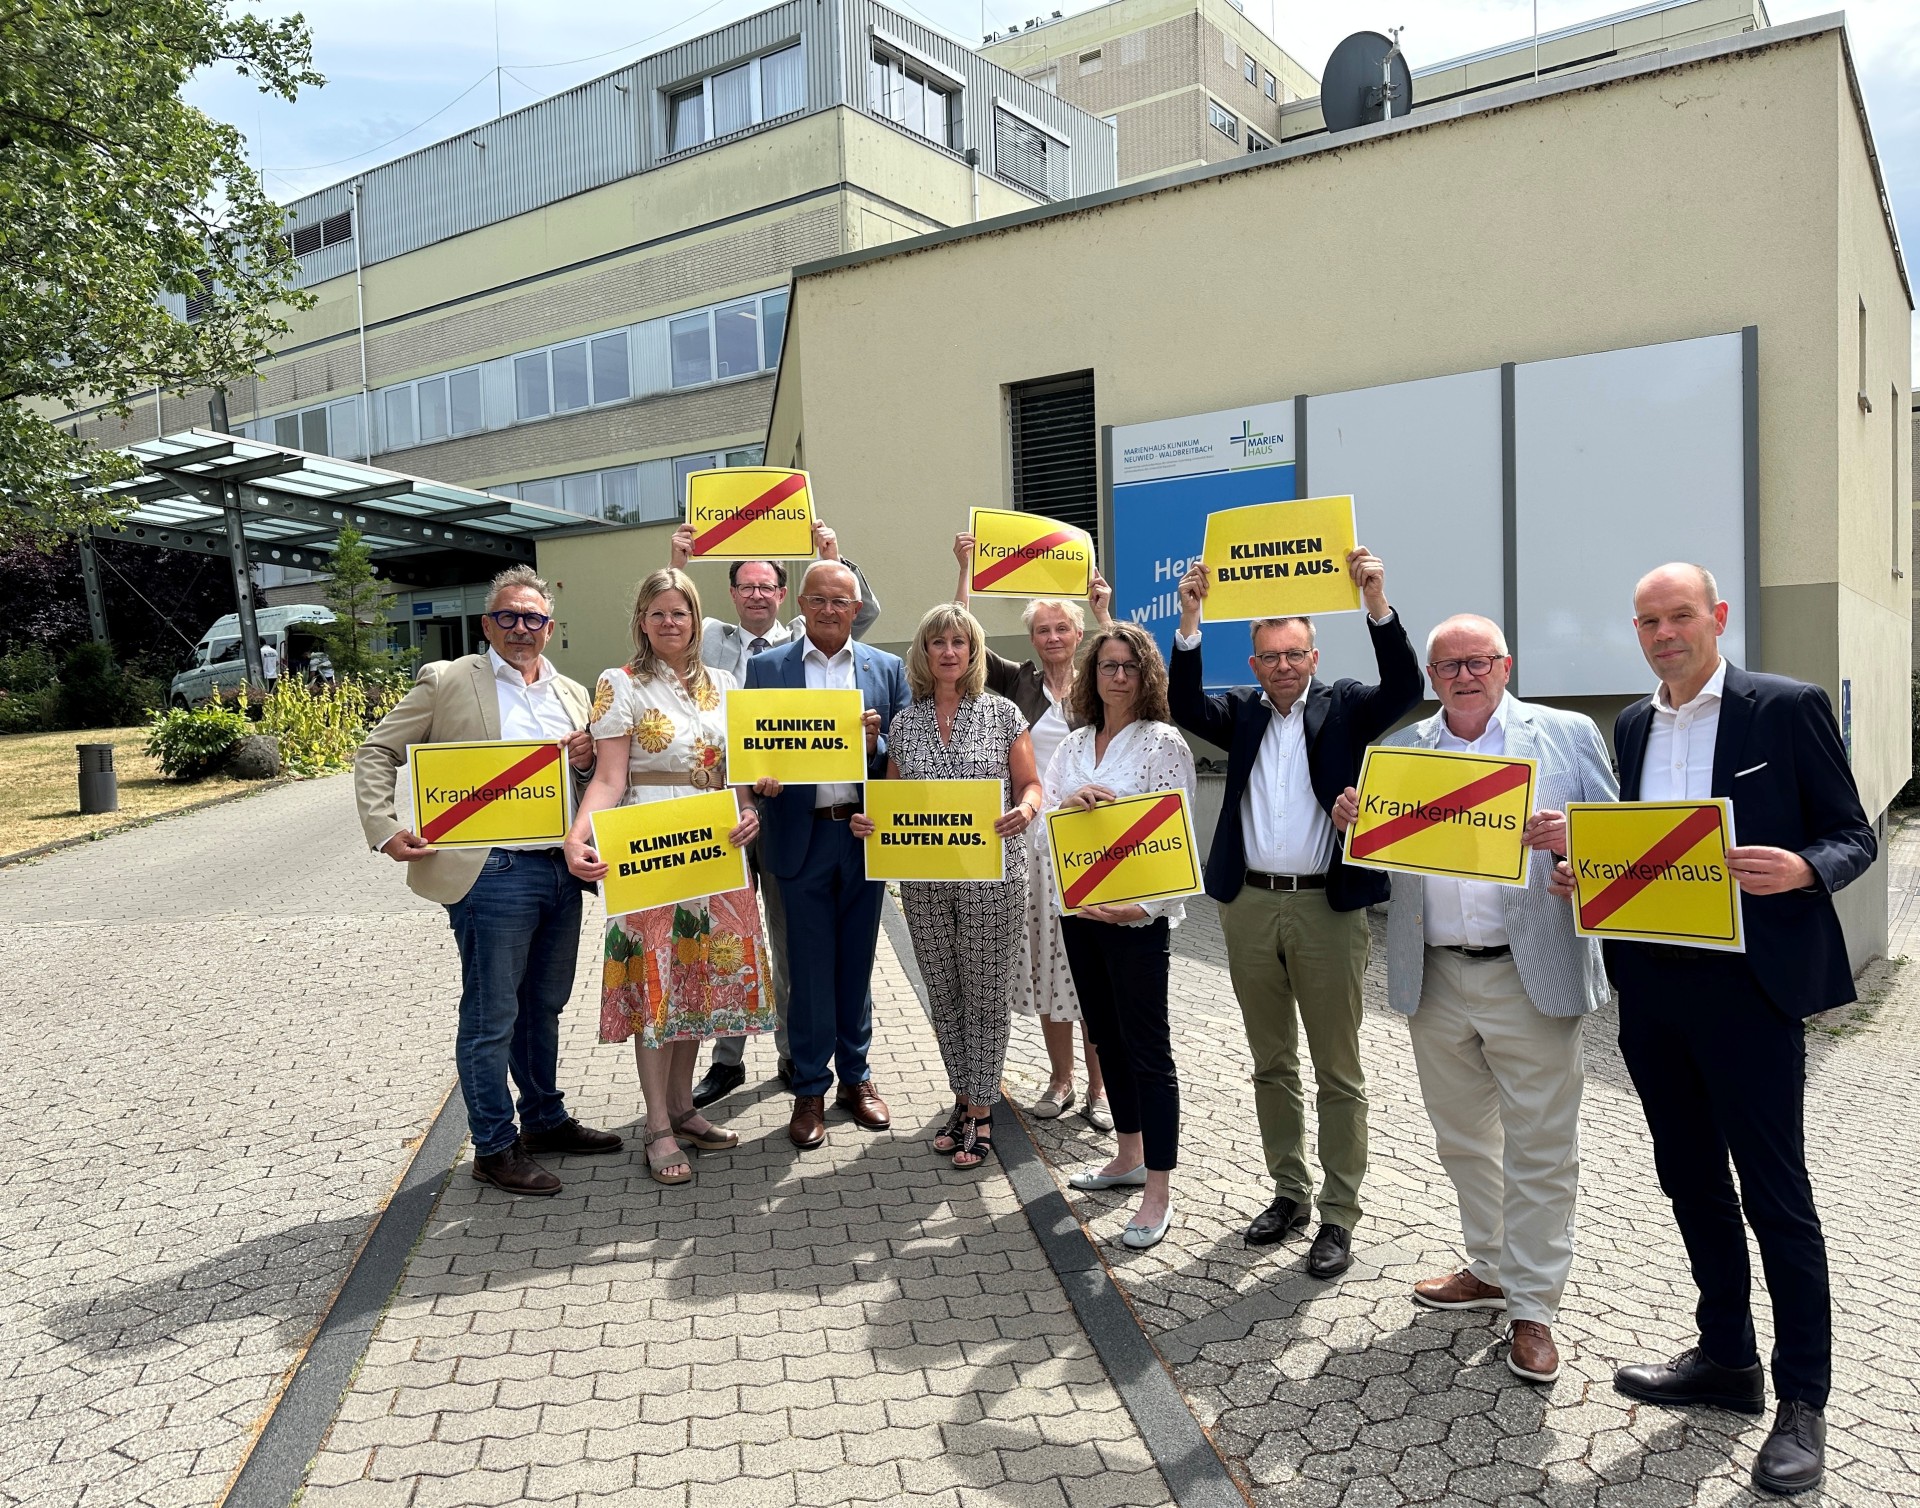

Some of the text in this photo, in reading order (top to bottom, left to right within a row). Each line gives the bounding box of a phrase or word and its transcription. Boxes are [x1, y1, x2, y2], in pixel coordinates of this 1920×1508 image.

[1123, 438, 1200, 456] MARIENHAUS KLINIKUM
[1247, 434, 1284, 448] MARIEN
[1247, 445, 1273, 457] HAUS
[1123, 453, 1154, 463] NEUWIED
[1158, 445, 1213, 459] WALDBREITBACH
[696, 505, 806, 521] Krankenhaus
[979, 542, 1085, 561] Krankenhaus
[1230, 537, 1323, 560] KLINIKEN
[1154, 555, 1202, 583] Her
[1217, 558, 1340, 582] BLUTEN AUS.
[1130, 591, 1183, 623] willk
[755, 719, 836, 732] KLINIKEN
[743, 737, 849, 750] BLUTEN AUS.
[425, 782, 556, 804] Krankenhaus
[893, 813, 973, 827] KLINIKEN
[1364, 794, 1516, 831] Krankenhaus
[629, 827, 713, 855] KLINIKEN
[880, 832, 987, 846] BLUTEN AUS.
[618, 845, 727, 877] BLUTEN AUS.
[1063, 835, 1183, 869] Krankenhaus
[1577, 857, 1723, 883] Krankenhaus
